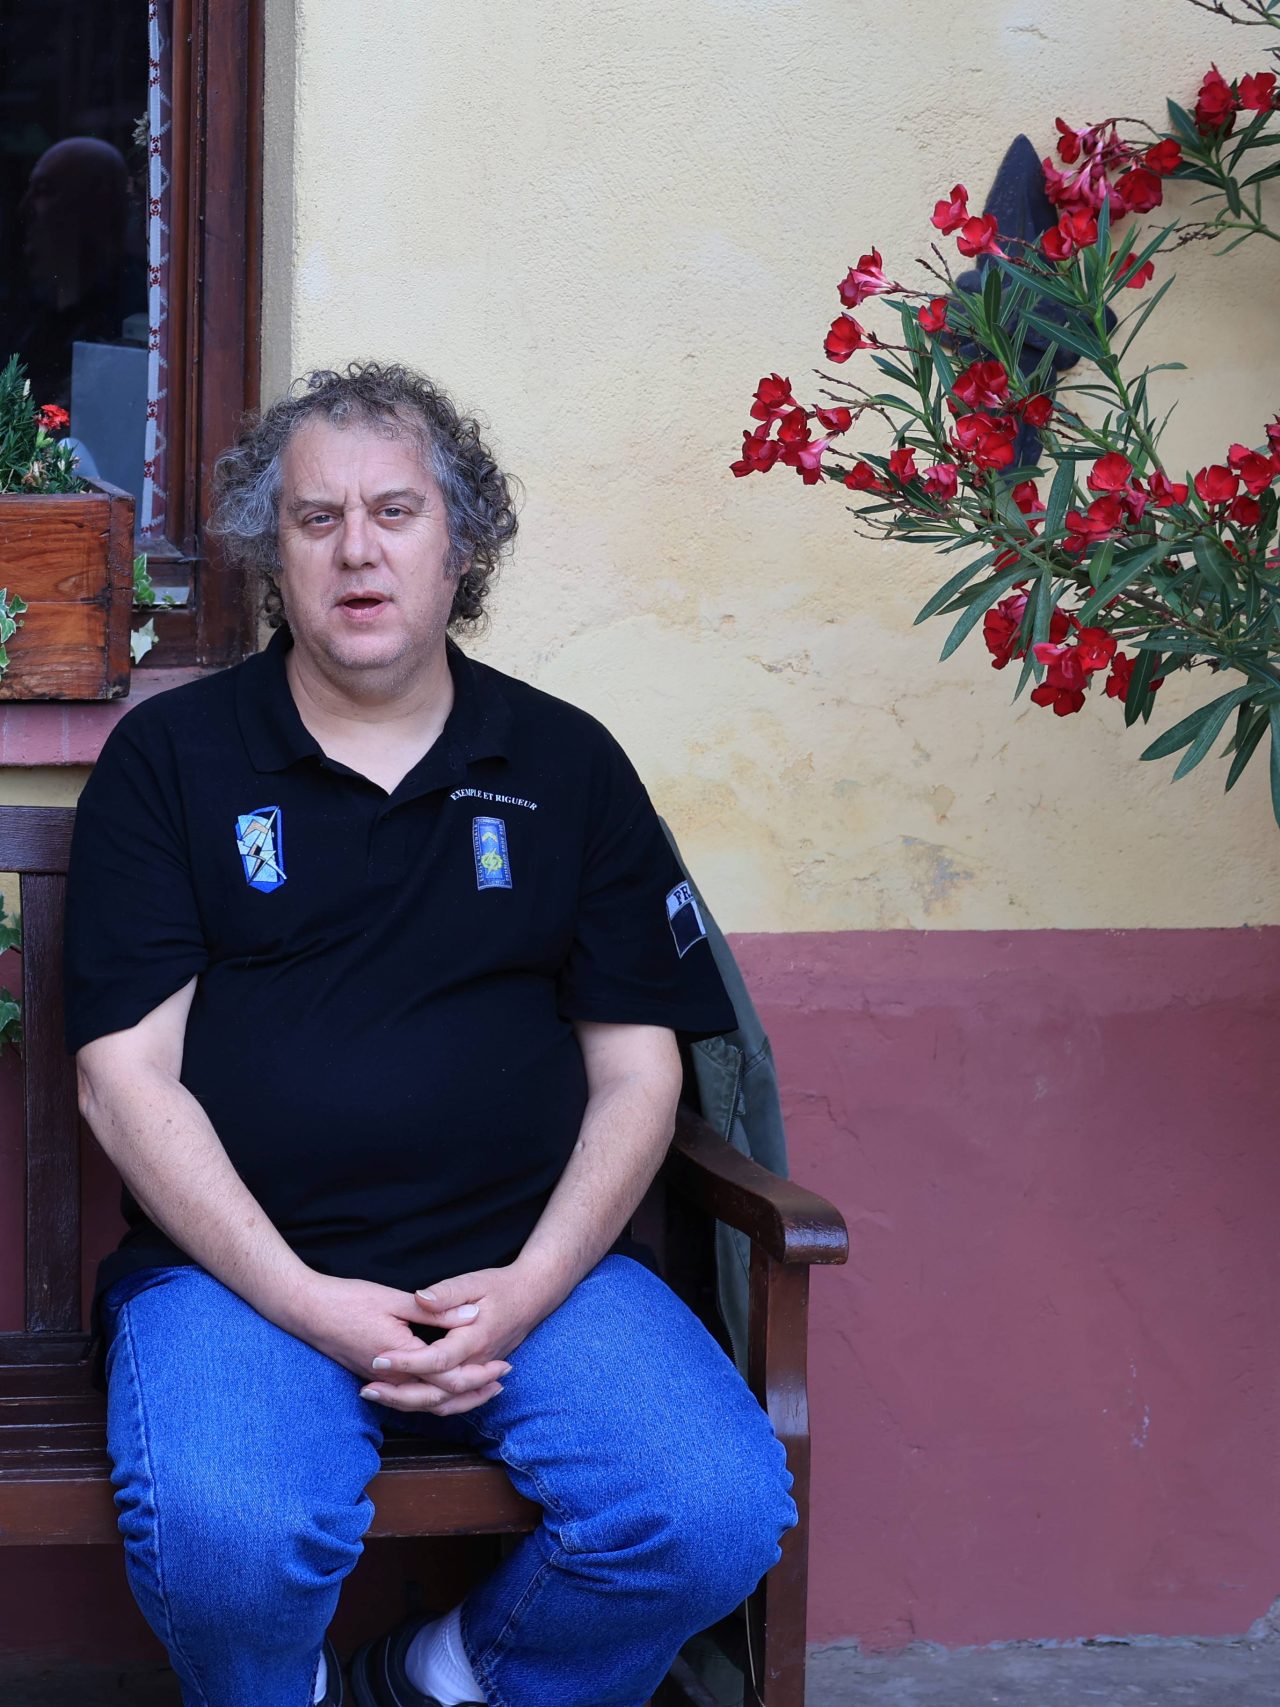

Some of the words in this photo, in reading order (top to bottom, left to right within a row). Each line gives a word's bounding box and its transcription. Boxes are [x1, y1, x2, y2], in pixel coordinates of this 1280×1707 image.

[450, 788, 483, 801] EXEMPLE
[483, 791, 494, 801] ET
[495, 794, 538, 811] RIGUEUR
